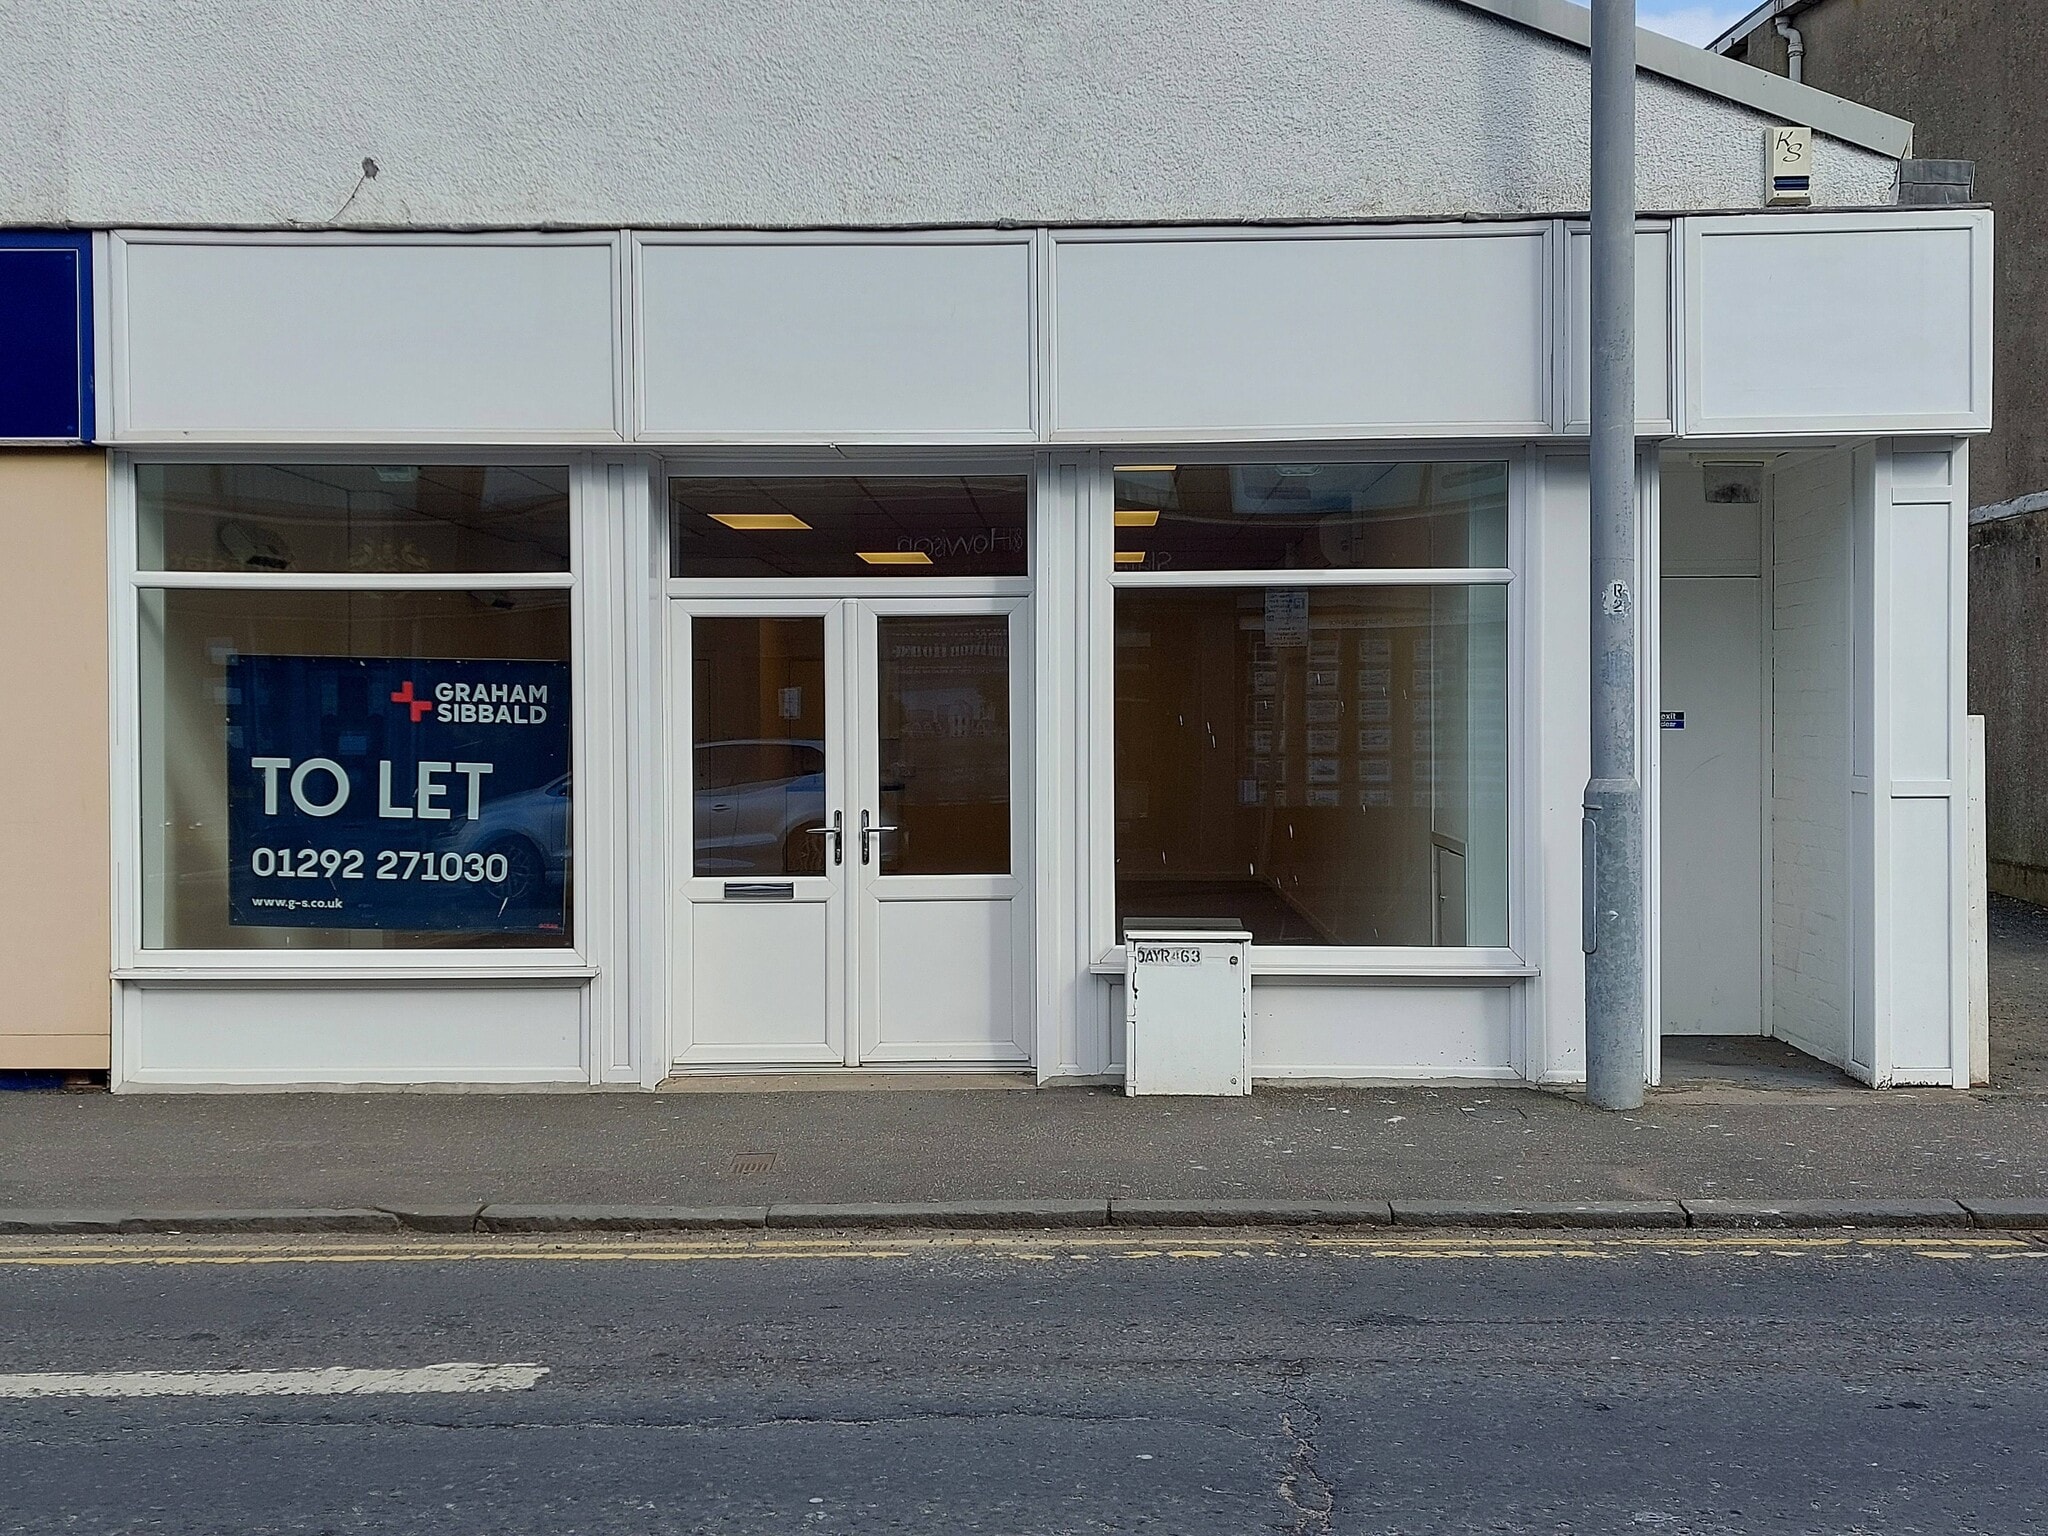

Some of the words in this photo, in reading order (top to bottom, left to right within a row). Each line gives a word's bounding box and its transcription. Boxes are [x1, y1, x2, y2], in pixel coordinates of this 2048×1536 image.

[435, 682, 548, 703] GRAHAM
[437, 703, 548, 724] SIBBALD
[251, 757, 351, 818] TO
[379, 760, 494, 821] LET
[252, 847, 364, 880] 01292
[376, 850, 509, 883] 271030
[252, 897, 343, 910] www.g-s.co.uk
